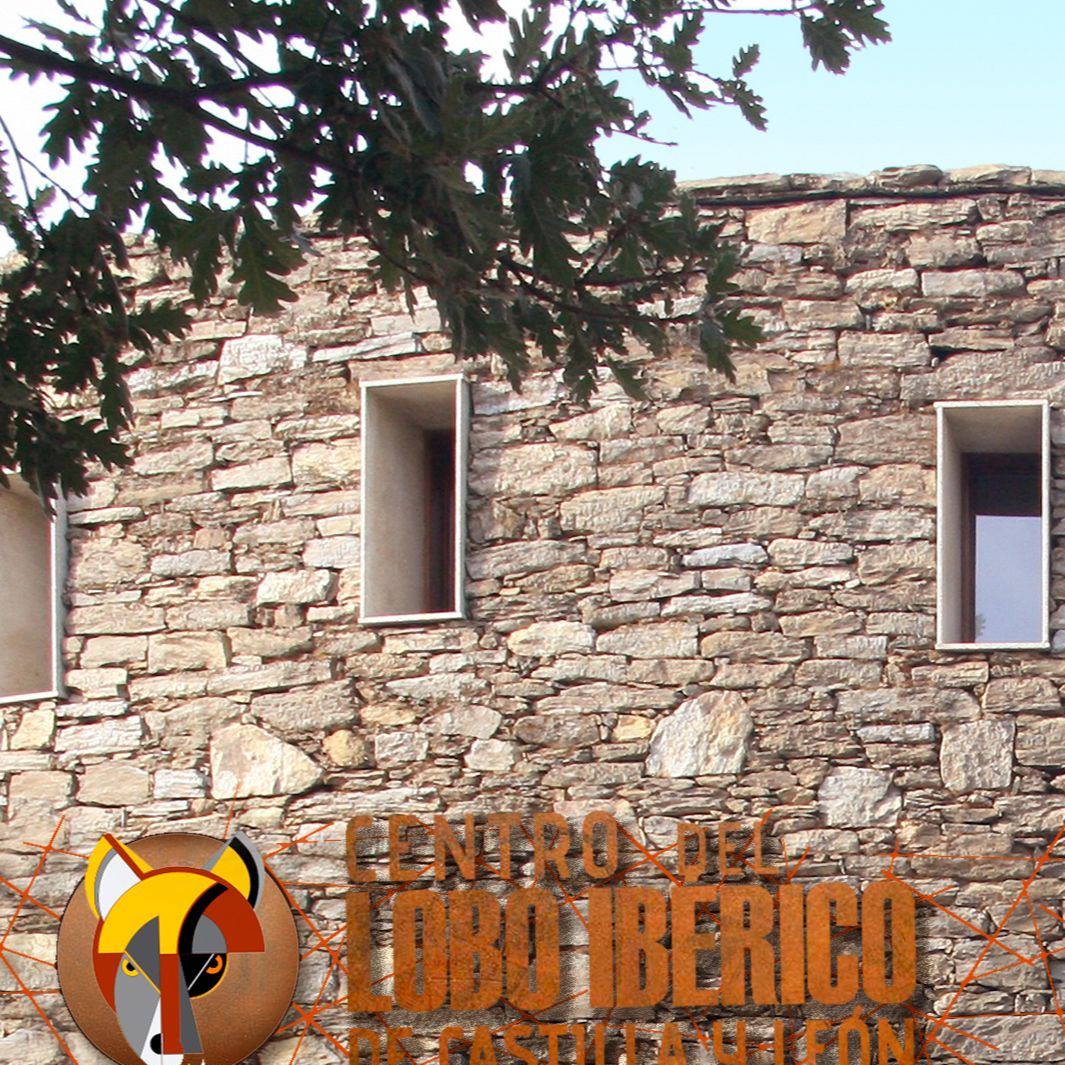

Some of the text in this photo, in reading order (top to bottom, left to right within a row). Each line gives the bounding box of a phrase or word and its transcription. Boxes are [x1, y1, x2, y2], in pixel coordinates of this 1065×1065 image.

[346, 811, 780, 882] CENTRO DEL
[346, 888, 560, 1012] LOBO
